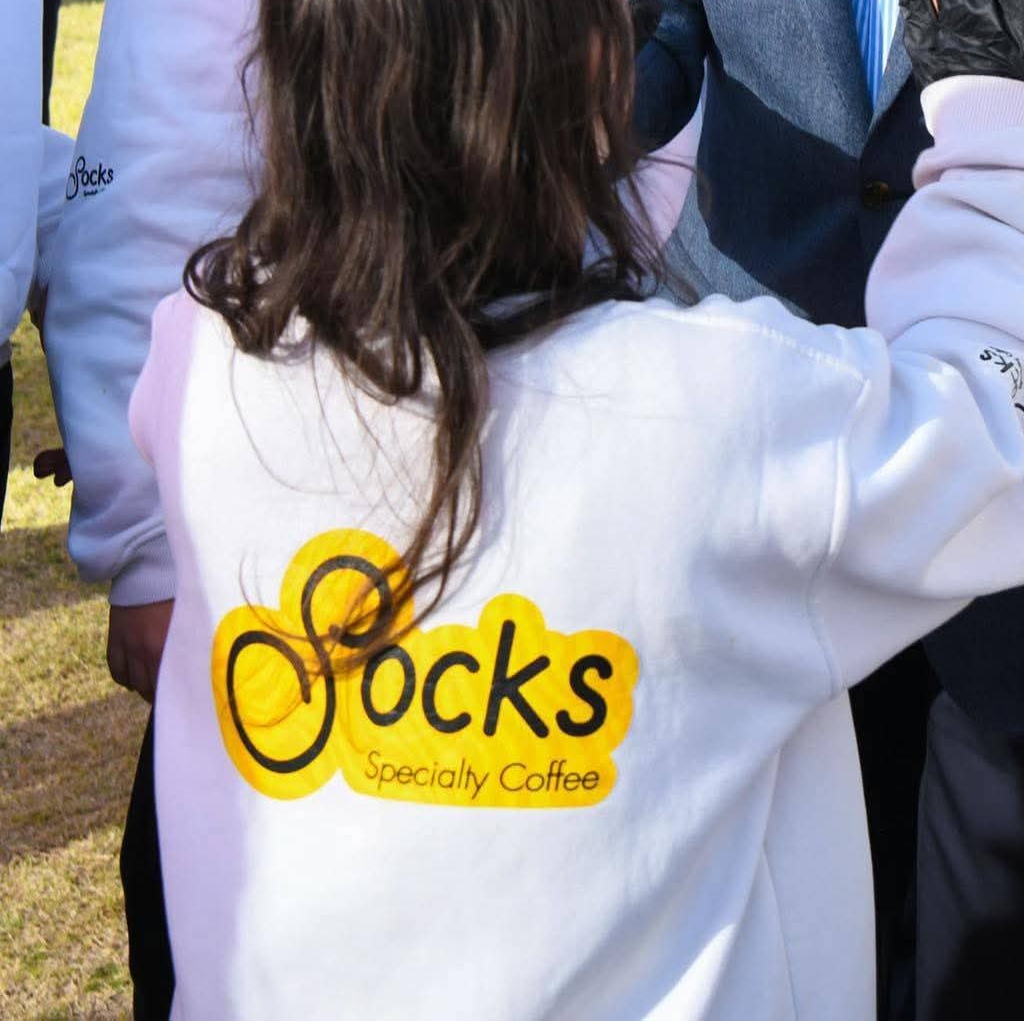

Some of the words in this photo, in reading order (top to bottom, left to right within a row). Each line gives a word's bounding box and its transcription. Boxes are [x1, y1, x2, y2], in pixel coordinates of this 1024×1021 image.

[66, 155, 114, 200] Socks
[227, 554, 613, 773] Socks
[364, 750, 490, 799] Specialty
[499, 759, 599, 792] Coffee
